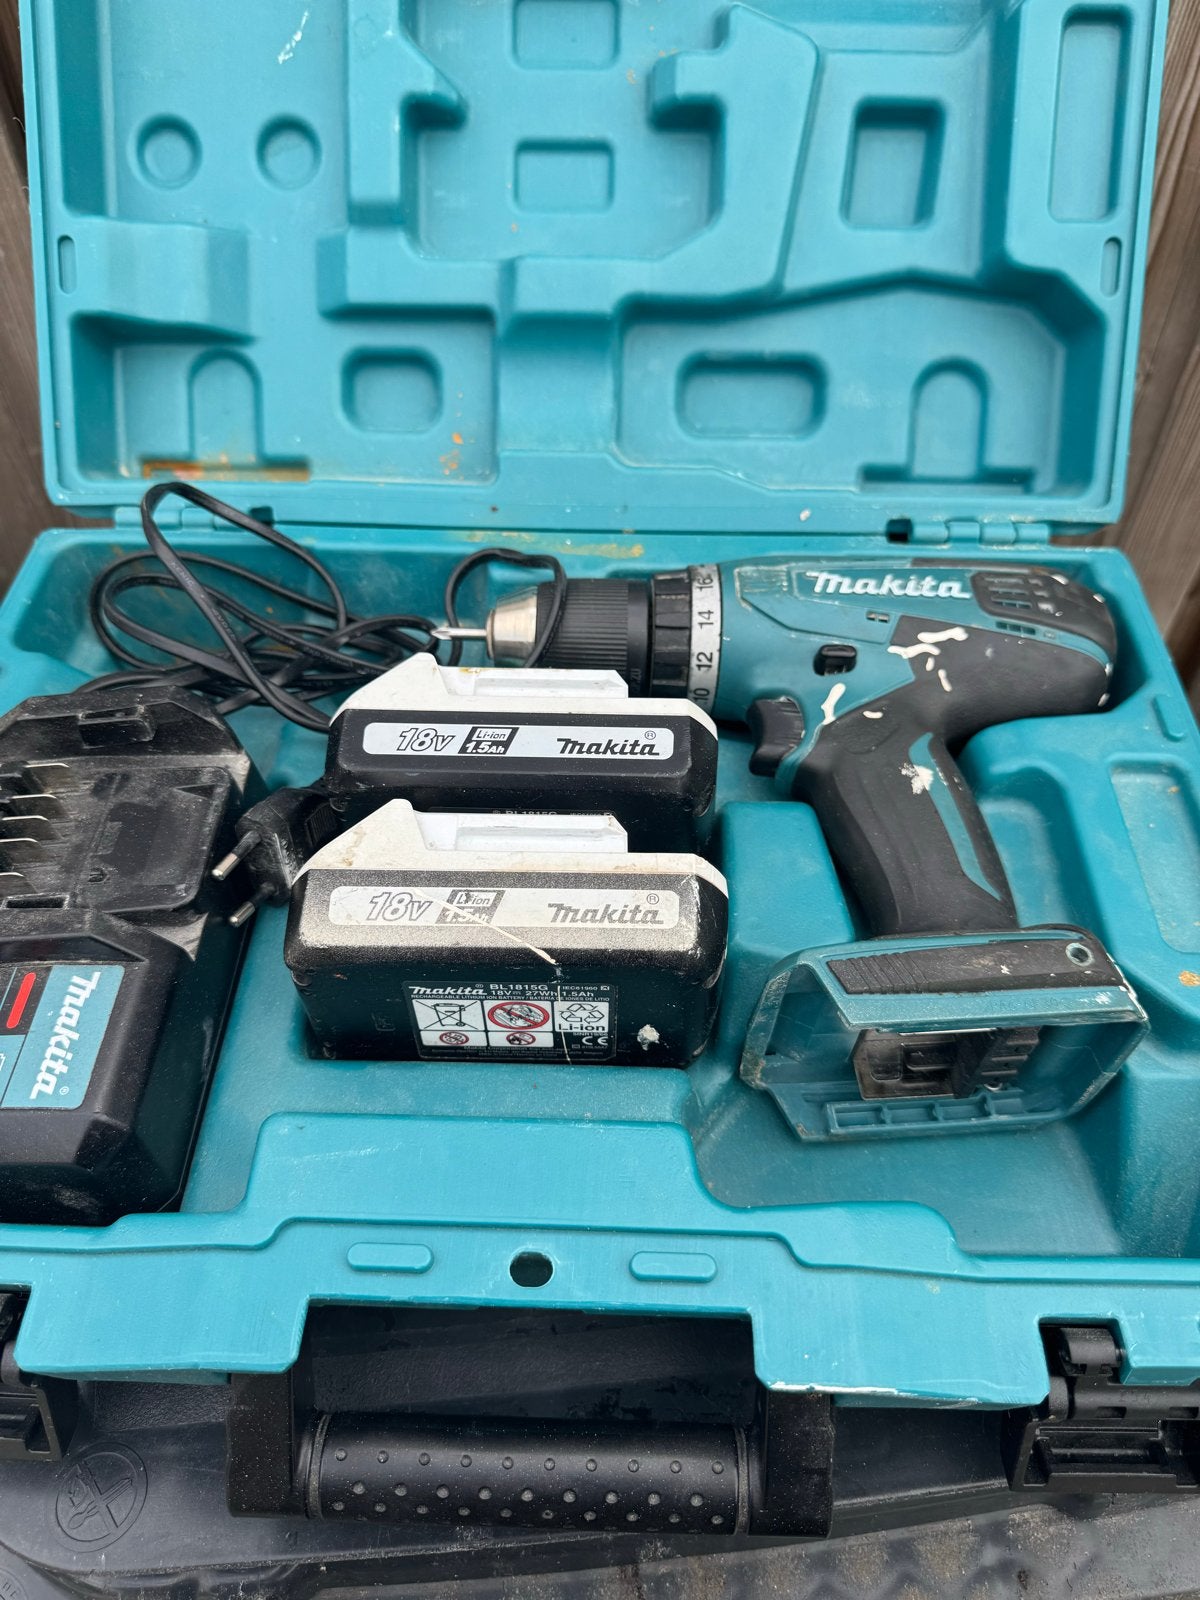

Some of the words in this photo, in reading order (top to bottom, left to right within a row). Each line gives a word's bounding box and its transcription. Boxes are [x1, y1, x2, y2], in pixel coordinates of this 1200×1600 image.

[696, 573, 714, 592] 16
[698, 609, 714, 629] 14
[696, 651, 713, 673] 12
[476, 730, 507, 740] Li-ion
[465, 741, 505, 754] 1.5Ah
[489, 983, 549, 991] BL1815G
[558, 1023, 606, 1032] Li-ion
